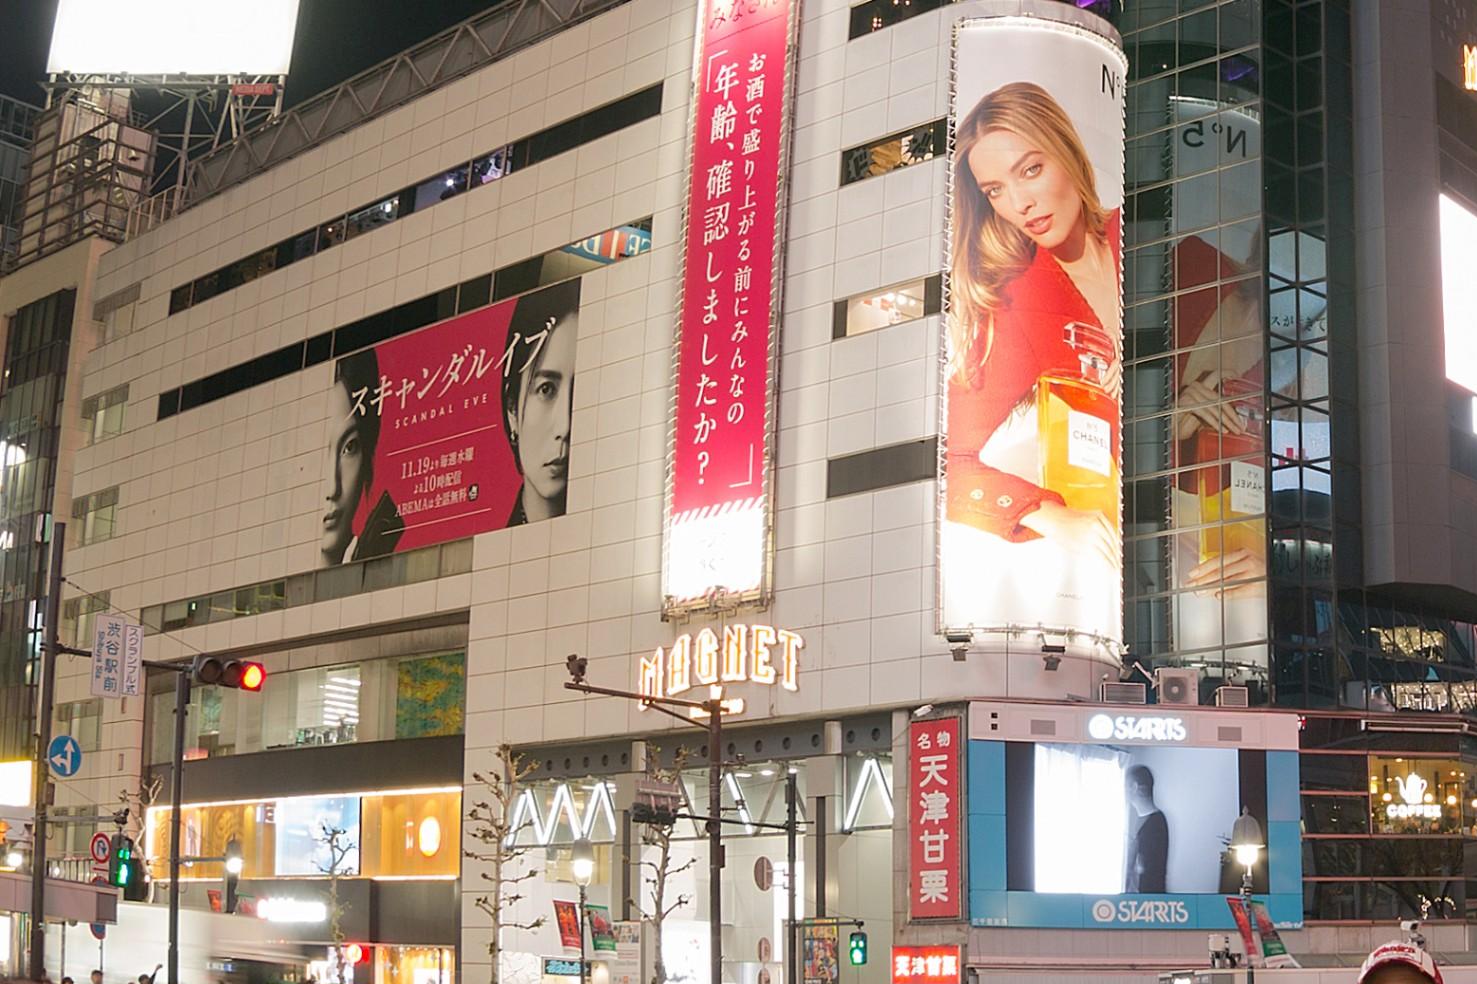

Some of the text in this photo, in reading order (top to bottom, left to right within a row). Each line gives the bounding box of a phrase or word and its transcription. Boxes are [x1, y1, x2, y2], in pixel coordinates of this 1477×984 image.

[347, 316, 557, 421] スキャンダルイブ
[394, 393, 488, 429] SCANDAL EVE
[103, 622, 121, 692] 渋谷駅前
[125, 627, 140, 694] スクランブル式
[638, 623, 807, 712] MAGNET
[917, 731, 951, 750] 名物
[919, 754, 950, 904] 天津甘栗
[1386, 803, 1442, 819] COFFEE
[1118, 899, 1188, 923] STARTS
[895, 955, 957, 978] 天津甘栗
